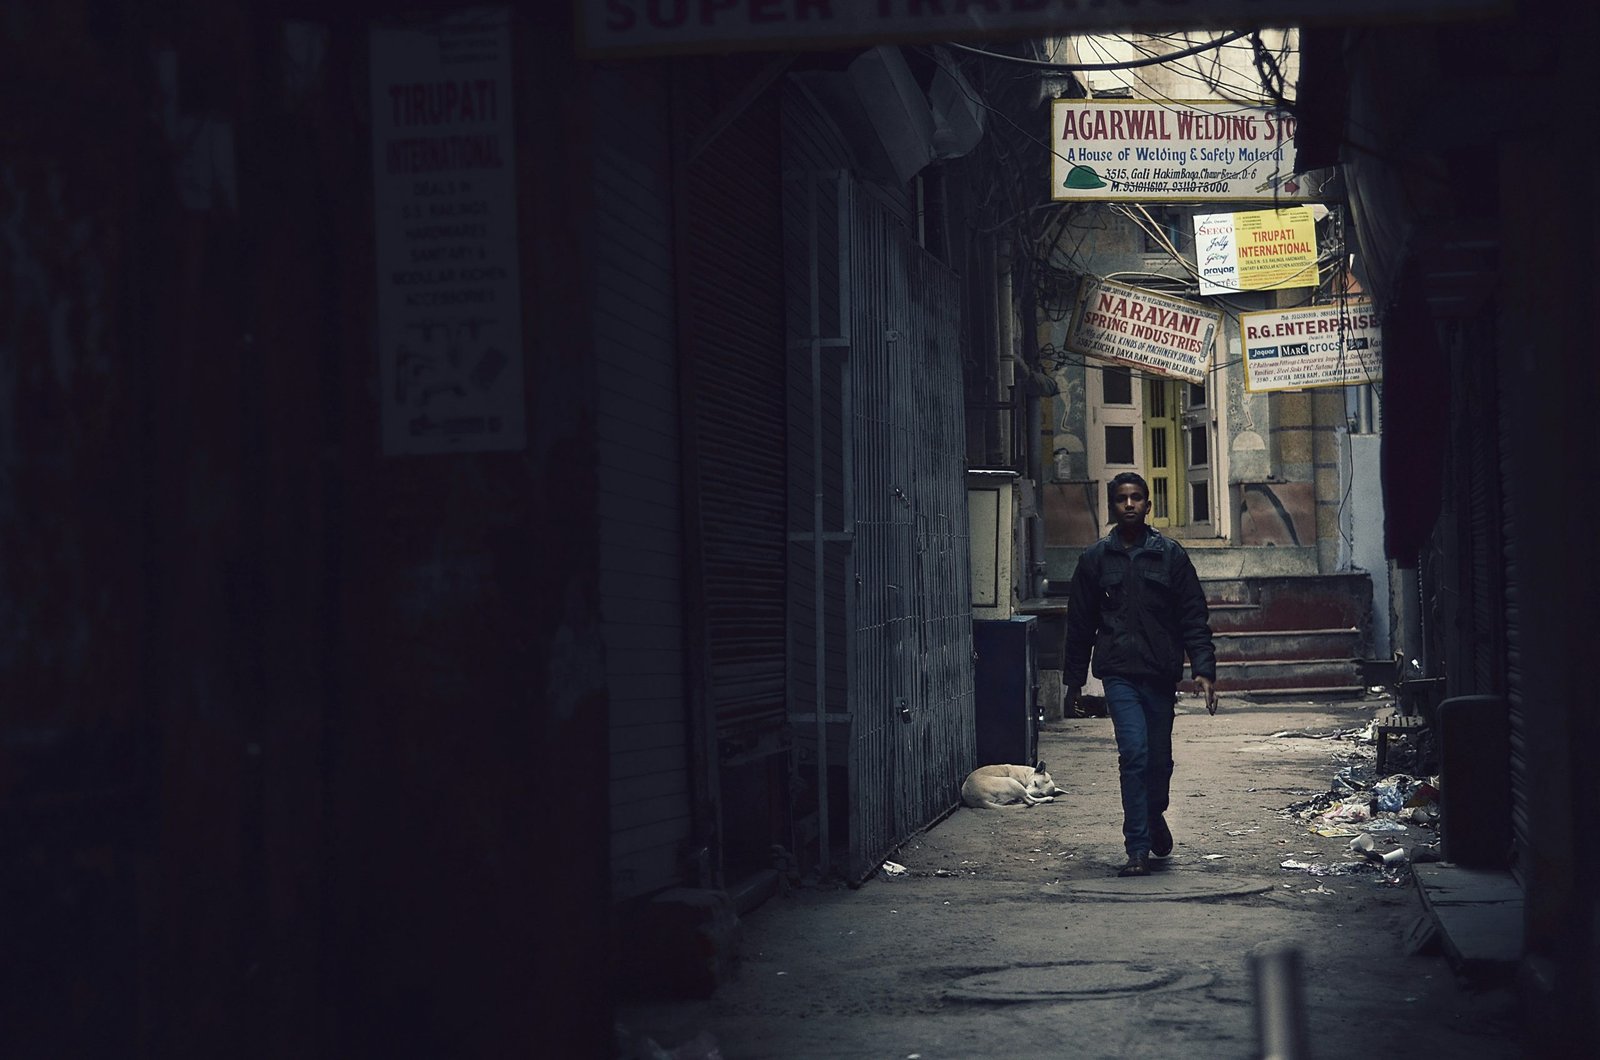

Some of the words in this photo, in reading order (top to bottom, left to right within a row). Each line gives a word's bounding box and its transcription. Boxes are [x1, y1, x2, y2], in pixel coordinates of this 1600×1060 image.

[388, 79, 496, 127] TIRUPATI
[1062, 109, 1171, 141] AGARWAL
[1175, 110, 1257, 141] WELDING
[386, 134, 503, 175] INTERNATIONAL
[1068, 148, 1075, 161] A
[1078, 147, 1113, 161] House
[1136, 147, 1187, 166] Welding
[1190, 147, 1198, 161] &
[1131, 168, 1150, 180] Gali
[1252, 229, 1295, 243] TIRUPATI
[1238, 242, 1312, 258] INTERNATIONAL
[1097, 293, 1201, 336] NARAYANI
[1084, 311, 1128, 333] SPRING
[1130, 324, 1203, 353] INDUSTRIES
[1104, 333, 1116, 344] ALL
[1117, 336, 1137, 349] KINDS
[1138, 342, 1146, 351] OF
[1146, 344, 1178, 360] MACHINERY
[1115, 347, 1133, 359] DAYA
